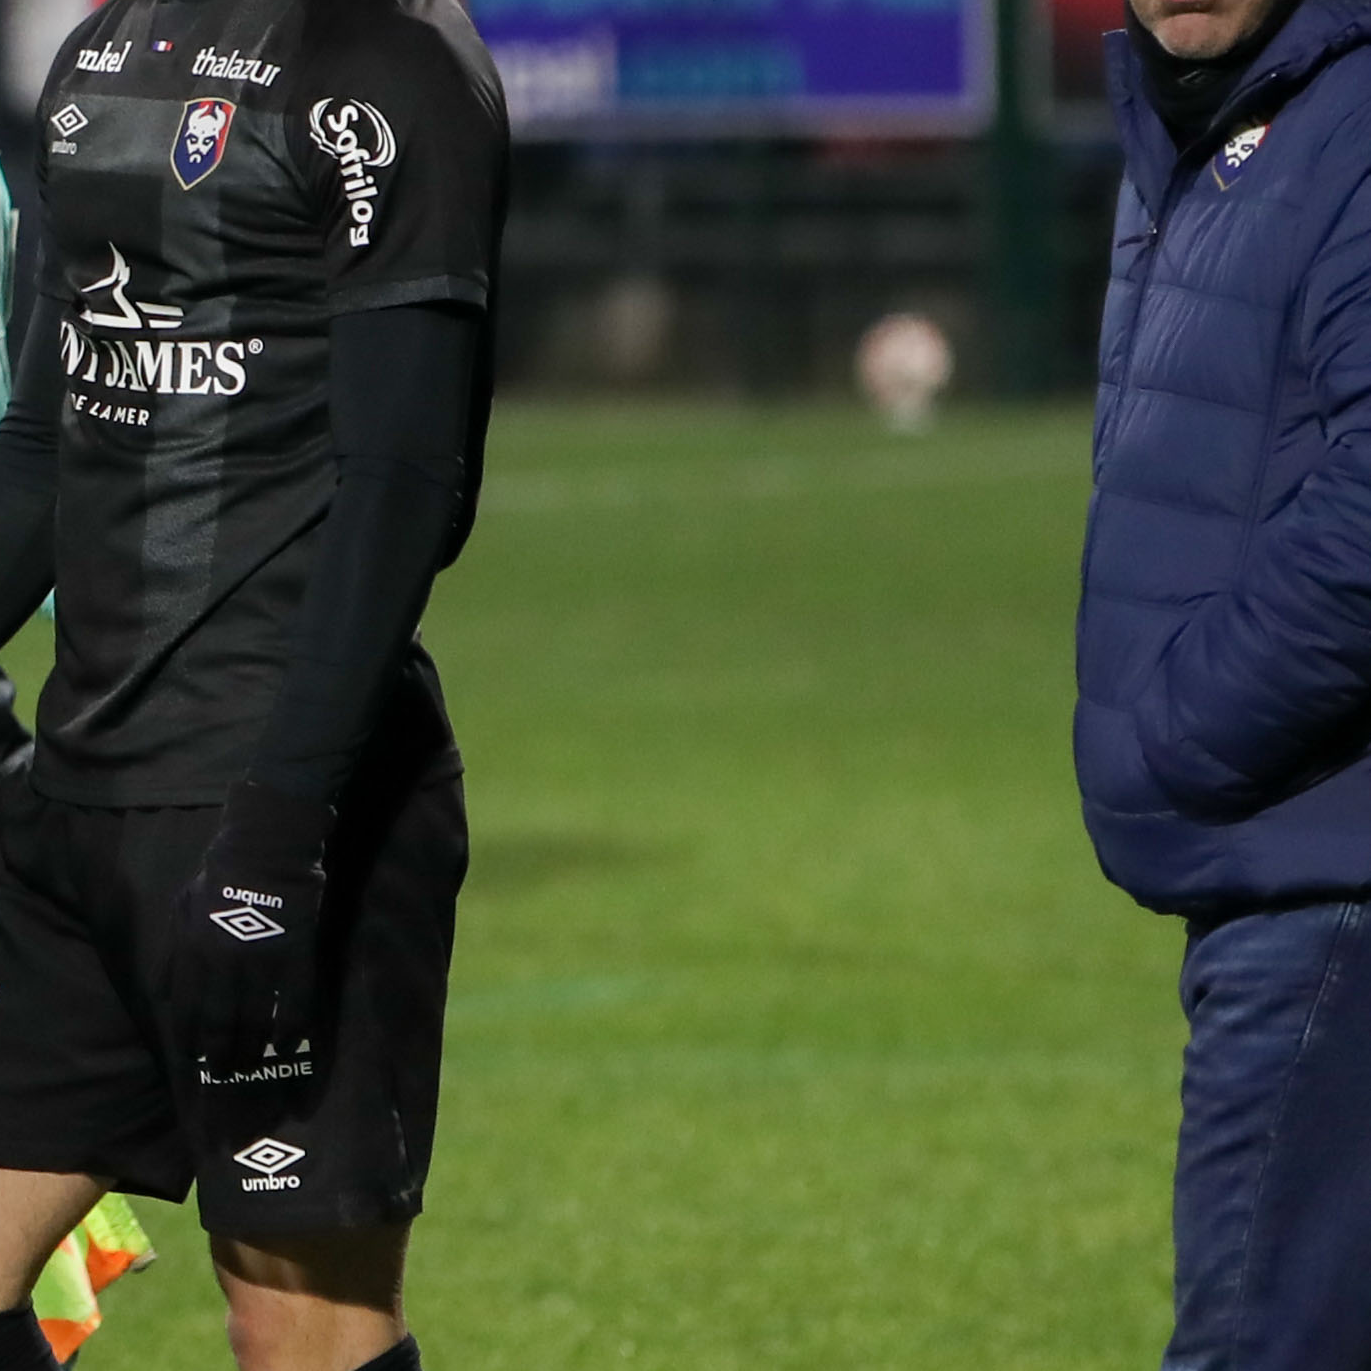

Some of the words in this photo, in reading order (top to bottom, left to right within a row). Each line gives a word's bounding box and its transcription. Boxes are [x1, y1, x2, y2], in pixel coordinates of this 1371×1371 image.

[191, 45, 283, 88] thalazur
[326, 103, 379, 248] Sofrilog
[222, 886, 284, 909] umbro
[199, 1061, 314, 1085] NMANDIE
[241, 1173, 301, 1193] umbro
